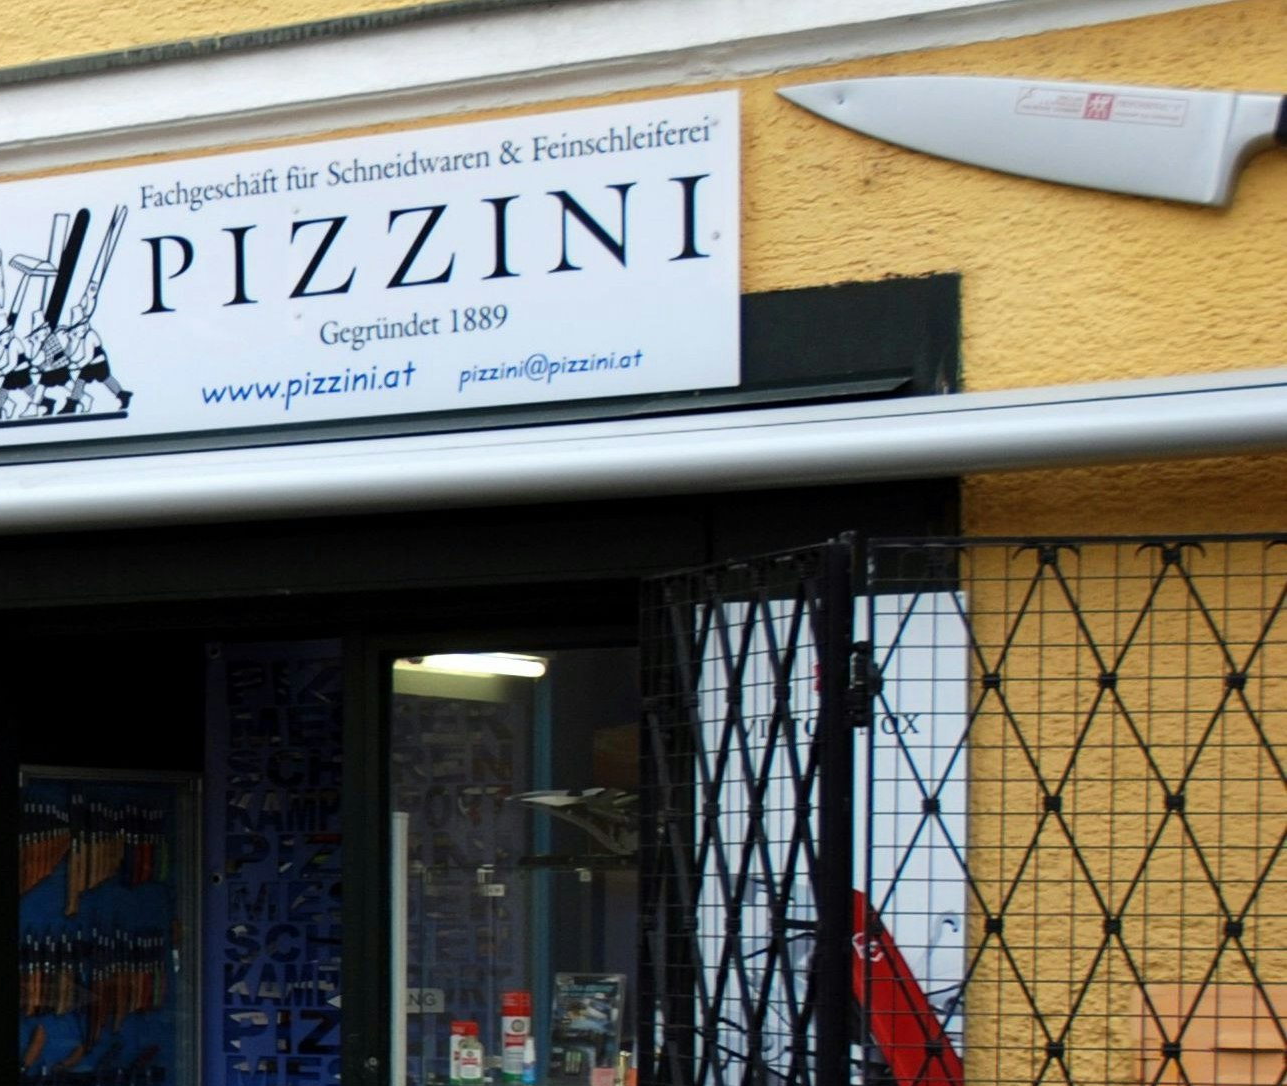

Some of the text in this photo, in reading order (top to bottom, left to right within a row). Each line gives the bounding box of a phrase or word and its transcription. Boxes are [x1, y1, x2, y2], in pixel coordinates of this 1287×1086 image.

[140, 121, 711, 208] Fachgeschäft für Schneidwaren & Feinschleiferei
[140, 173, 712, 315] PIZZINI
[319, 302, 509, 352] Gegründet 1889
[201, 361, 417, 410] www.pizzini.at
[458, 349, 644, 393] pizzini@pizzini.at
